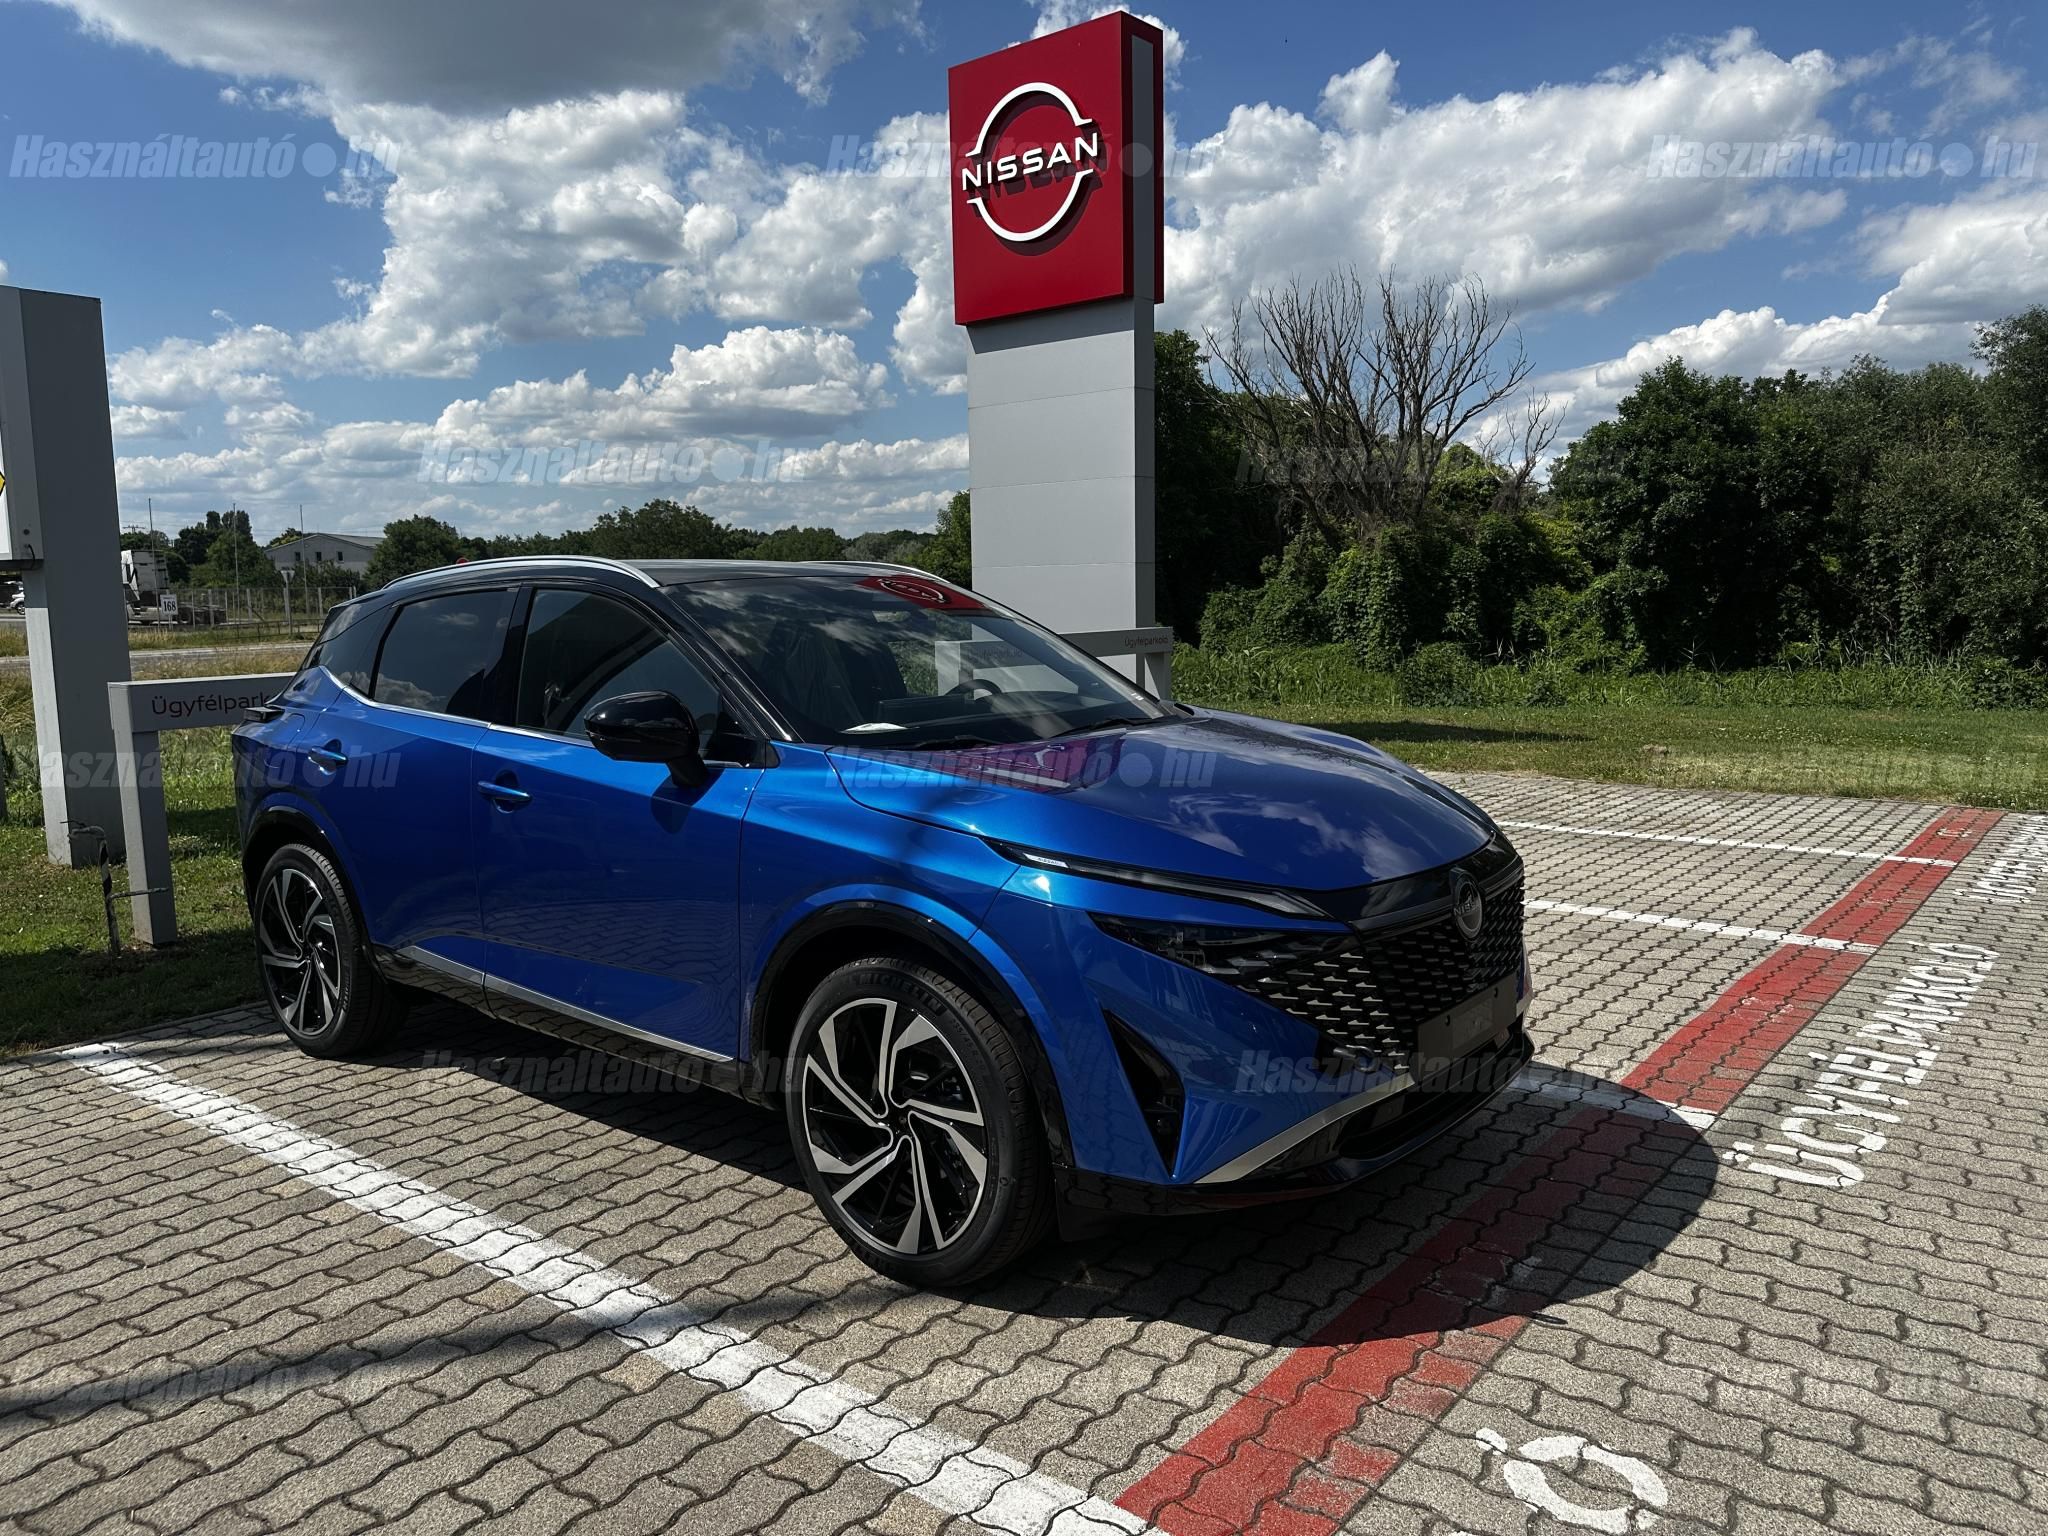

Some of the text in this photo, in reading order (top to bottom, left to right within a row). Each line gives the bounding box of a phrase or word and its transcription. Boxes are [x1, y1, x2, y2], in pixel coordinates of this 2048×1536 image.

[961, 132, 1098, 191] NISSAN
[163, 600, 177, 612] 168
[152, 692, 271, 718] Ügyfélpark
[859, 972, 946, 1016] MICHELIN
